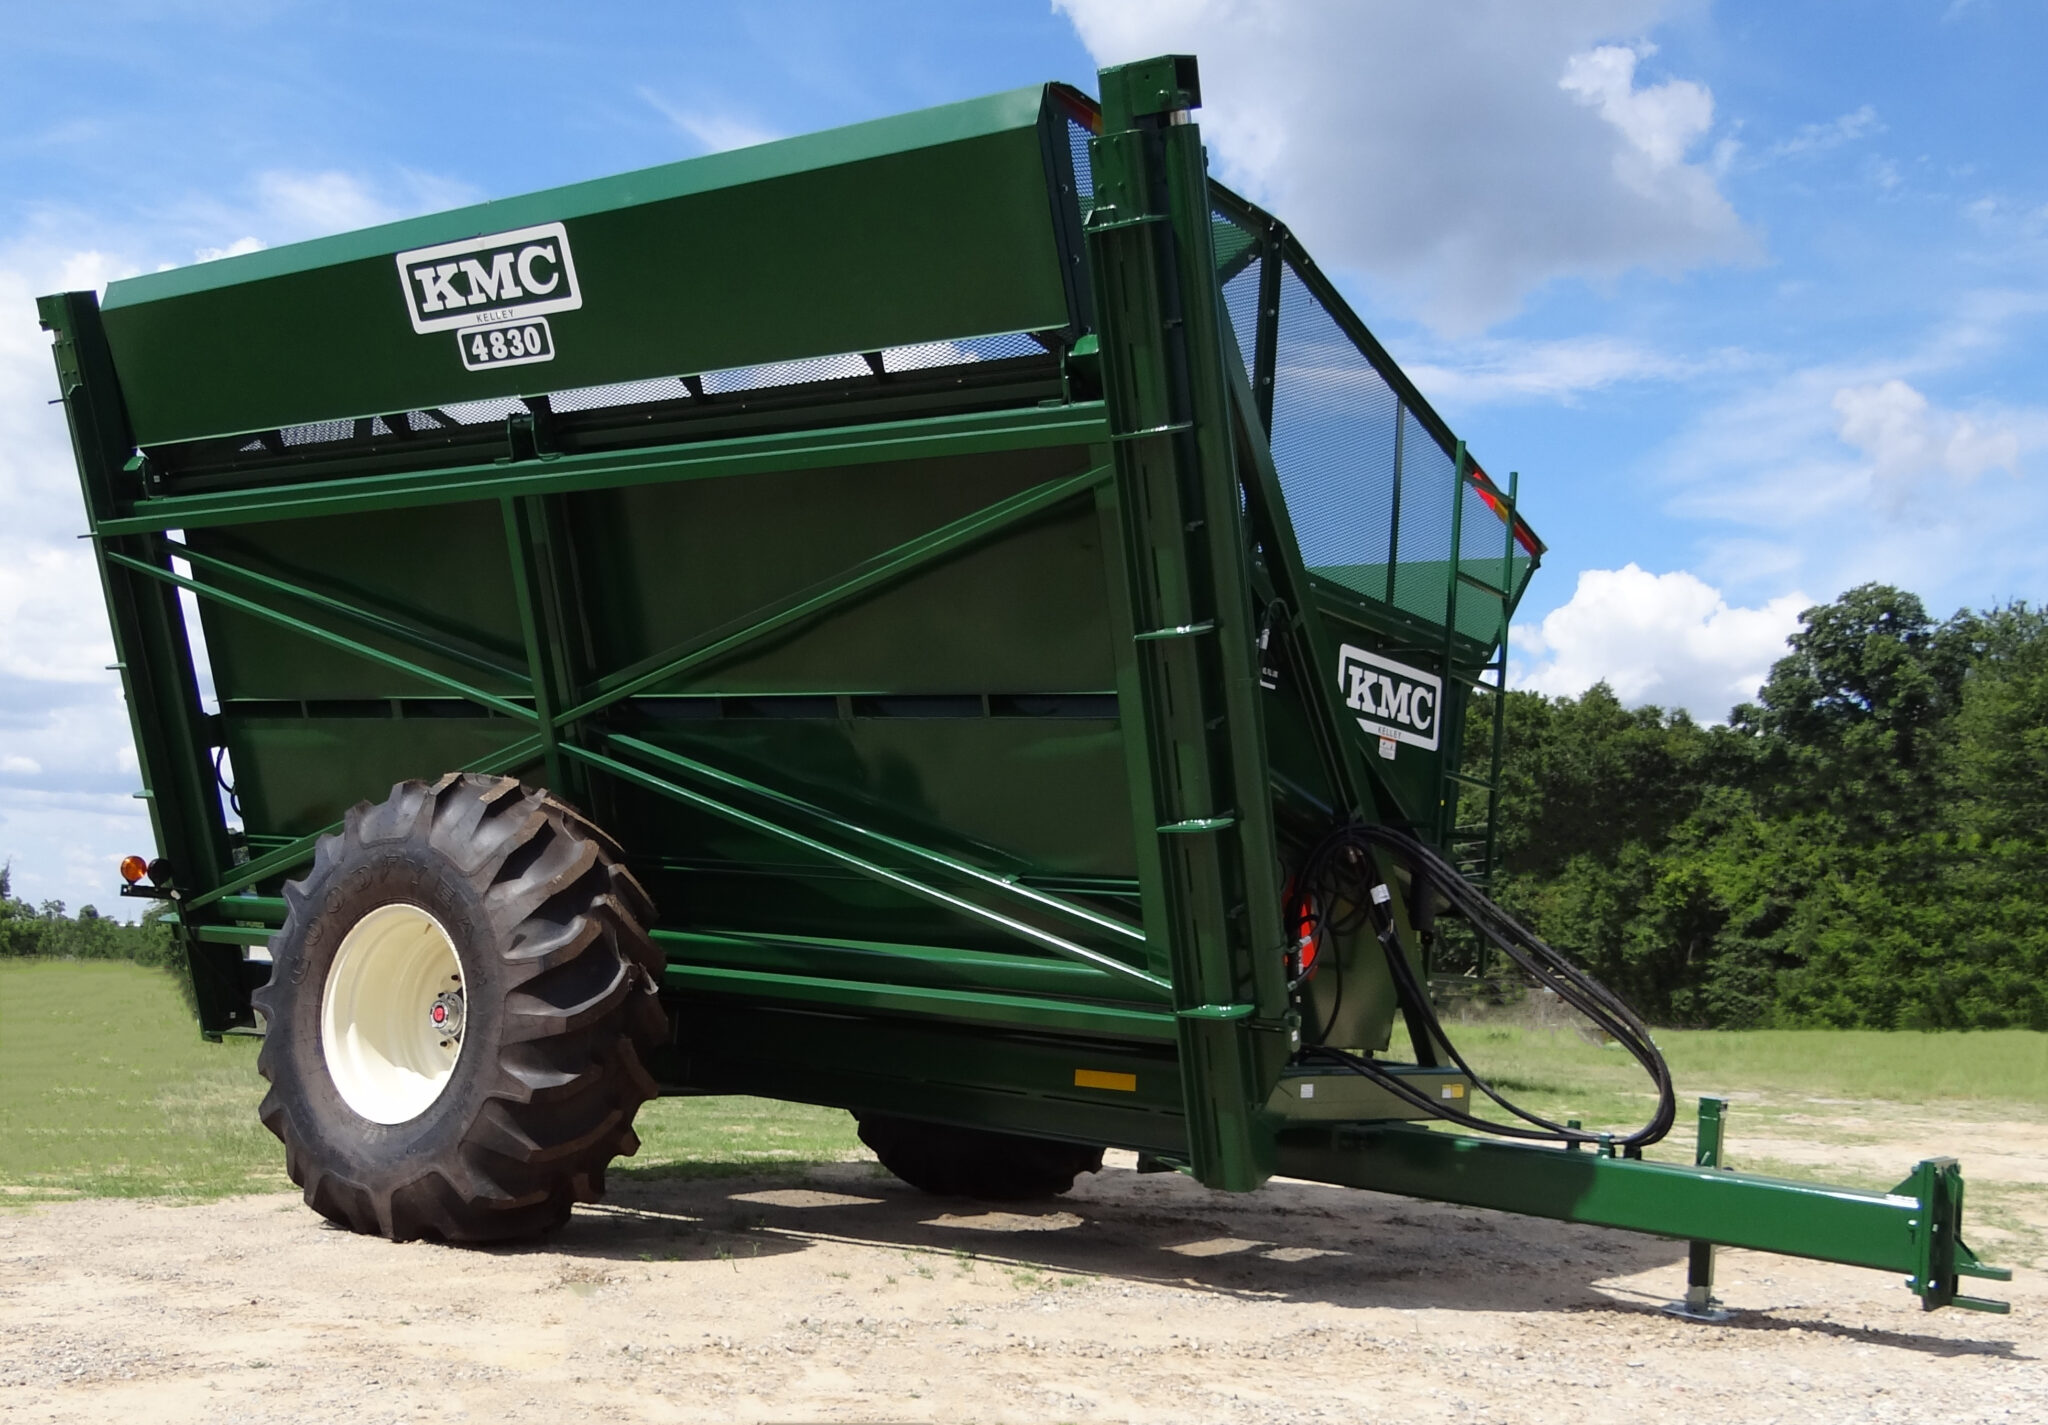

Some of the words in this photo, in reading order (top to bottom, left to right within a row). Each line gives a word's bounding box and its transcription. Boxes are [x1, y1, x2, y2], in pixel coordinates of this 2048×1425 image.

[414, 245, 559, 313] KMC
[476, 309, 514, 323] KELLEY
[472, 326, 542, 362] 4830
[1346, 665, 1433, 730] KMC
[1378, 726, 1402, 740] KELLEY
